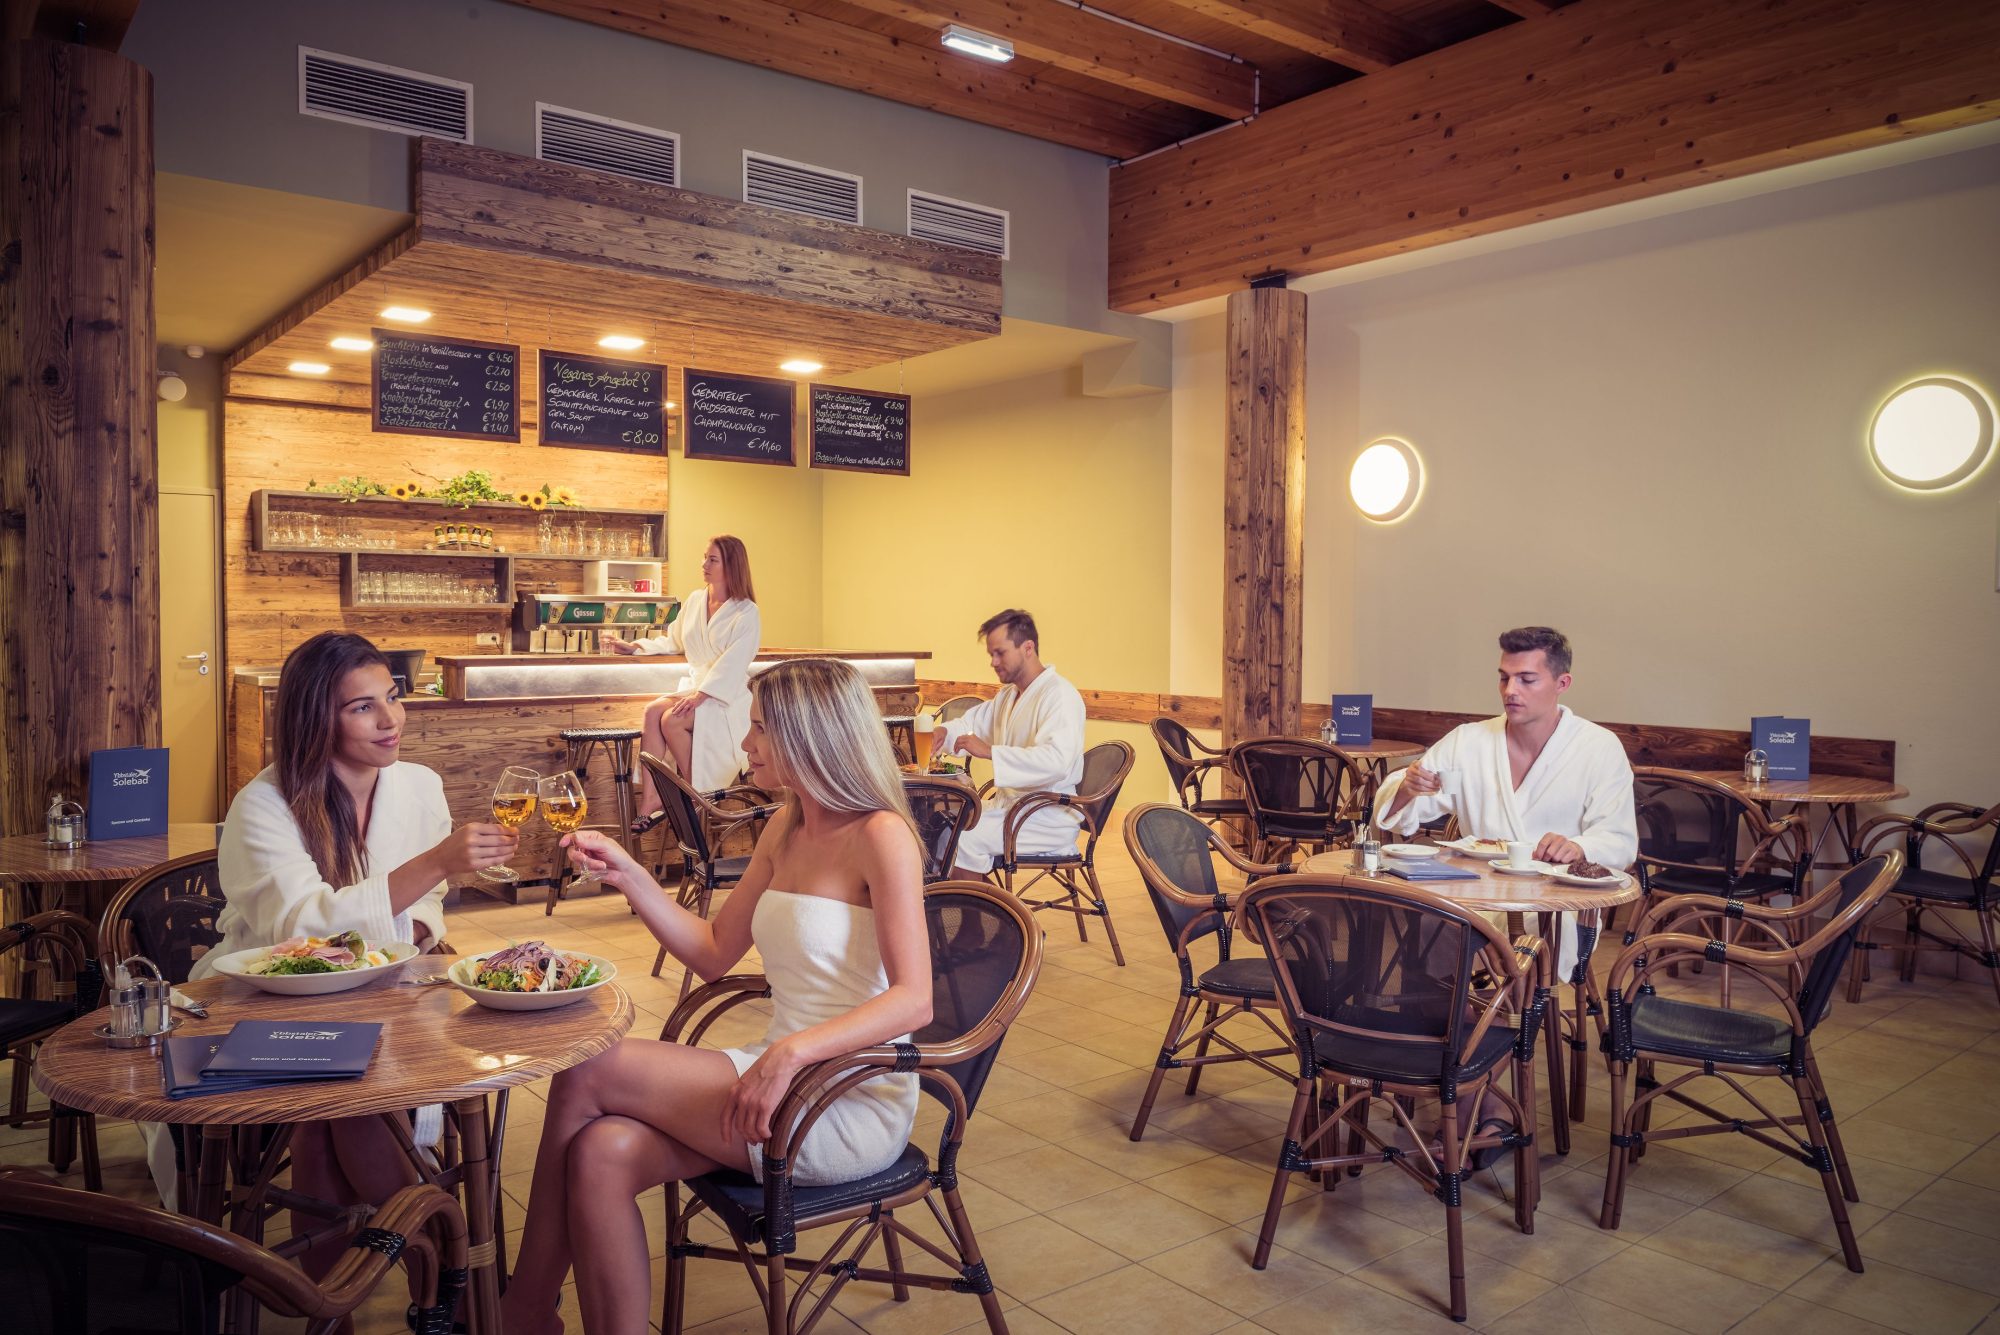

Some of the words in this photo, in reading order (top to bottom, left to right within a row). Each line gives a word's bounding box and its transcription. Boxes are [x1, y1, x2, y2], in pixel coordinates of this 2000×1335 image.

[421, 344, 429, 352] in
[430, 345, 471, 358] Vanillesauce
[381, 353, 435, 368] Mostschober
[553, 362, 597, 387] Veganes
[381, 390, 463, 410] Knoblauchstangerl
[547, 383, 600, 402] GEBACKENER
[638, 400, 655, 408] MIT
[692, 382, 752, 402] GEBRATENE
[380, 402, 452, 420] Speckstangerl
[452, 412, 459, 420] A
[547, 397, 632, 416] SCHNITTLAUCHSAUCE
[380, 415, 448, 431] Salzstangerl
[567, 411, 595, 421] SALAT
[694, 414, 767, 434] CHAMPIGNONREIS
[760, 412, 781, 420] MIT
[573, 607, 596, 618] Gösser
[1769, 736, 1795, 744] Solebad
[113, 777, 149, 787] Solebad
